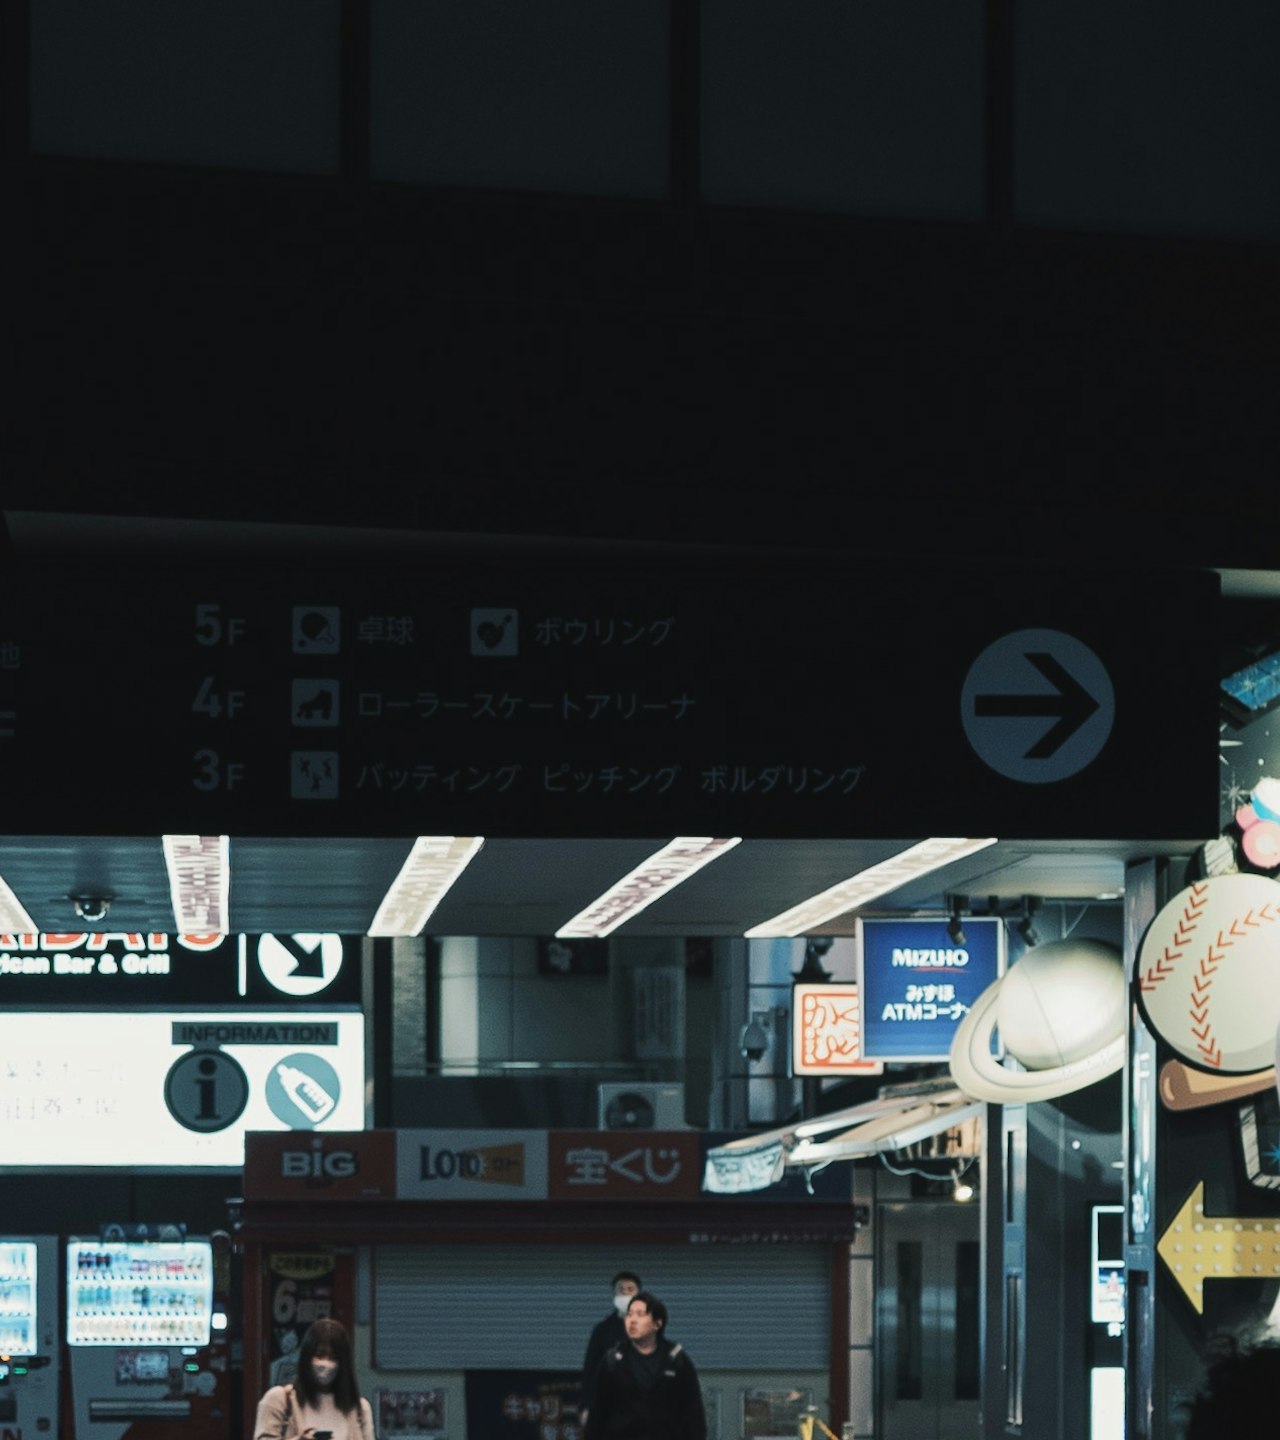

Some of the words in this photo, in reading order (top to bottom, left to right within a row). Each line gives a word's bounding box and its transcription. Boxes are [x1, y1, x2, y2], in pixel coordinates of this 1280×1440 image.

[193, 603, 247, 648] 5F
[355, 615, 415, 646] 卓球
[533, 616, 676, 647] ボウリング
[190, 676, 246, 719] 4F
[358, 691, 697, 721] ローラースケートアリーナ
[191, 747, 246, 792] 3F
[356, 764, 521, 794] バッティング
[543, 764, 682, 795] ピッチング
[700, 764, 868, 795] ボルダリング
[53, 953, 96, 974] Bar
[98, 953, 119, 974] &
[122, 953, 170, 974] Grill
[891, 948, 970, 967] MIZUHO
[905, 984, 956, 1002] みずほ
[881, 1002, 971, 1021] ATMコーナ
[182, 1025, 330, 1042] INFORMATION
[564, 1147, 682, 1184] 宝くじ
